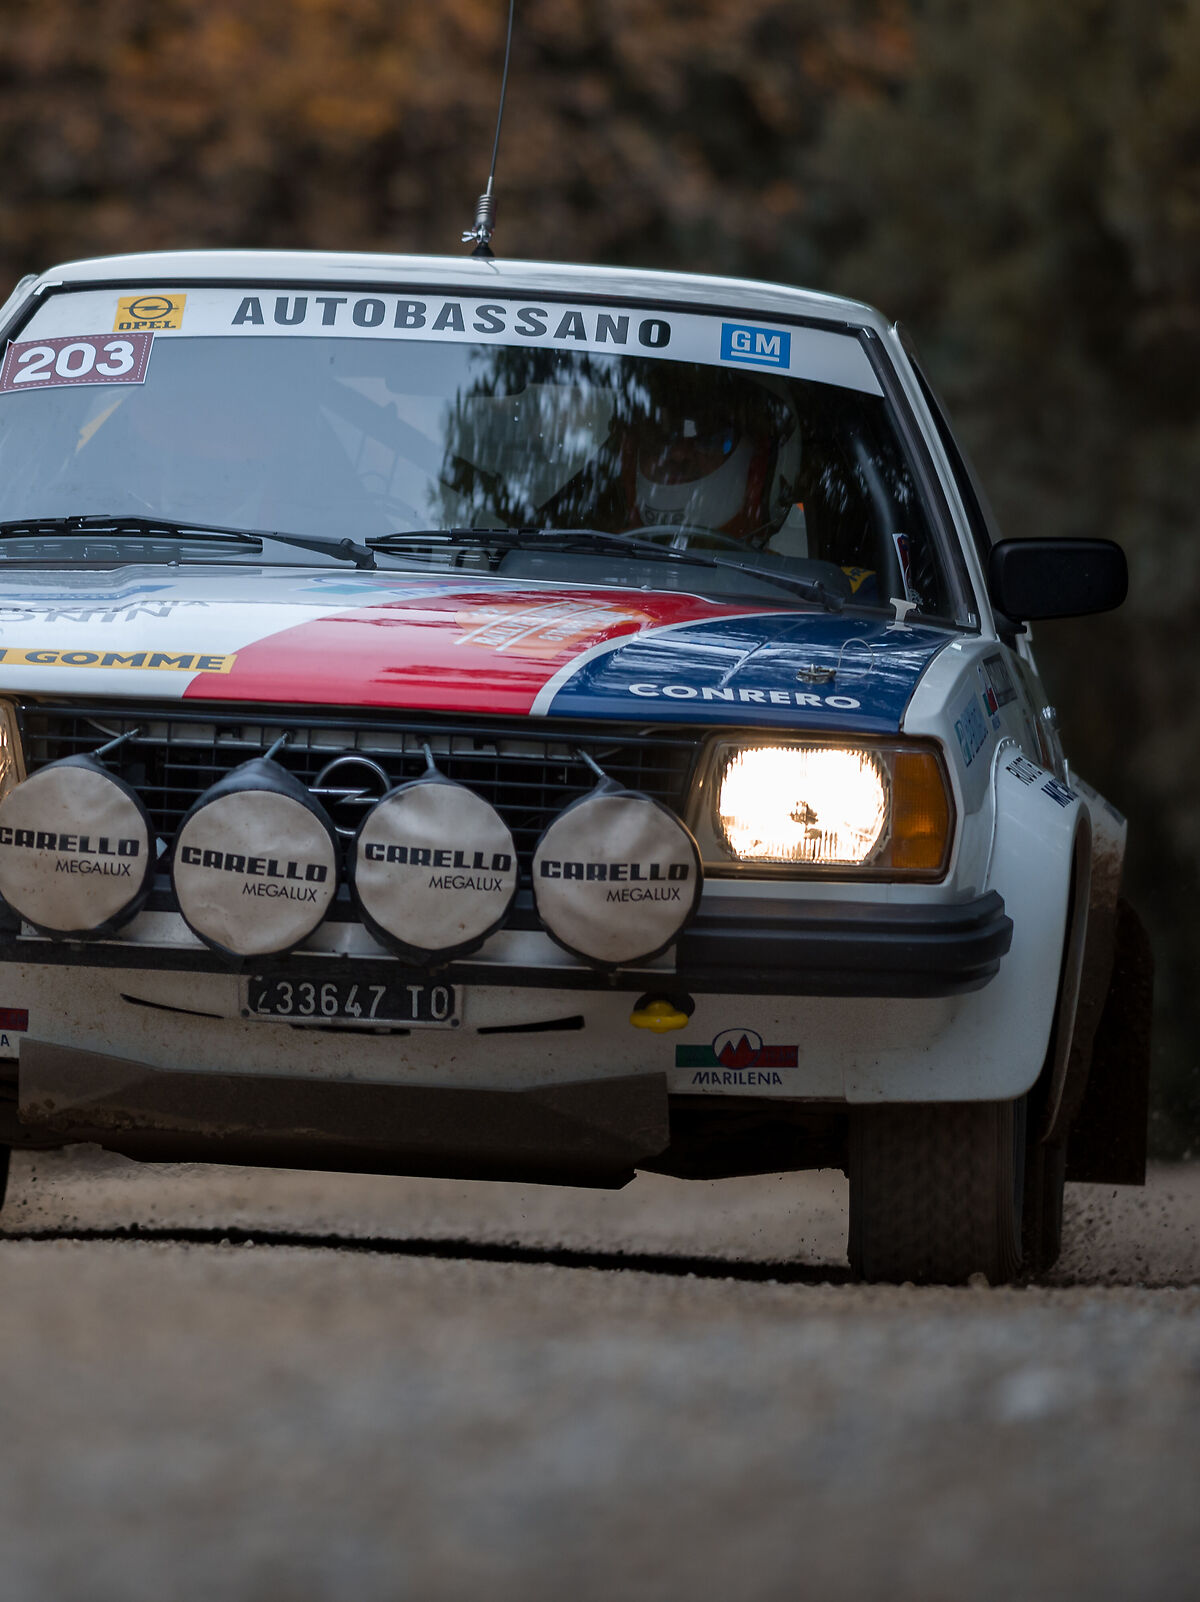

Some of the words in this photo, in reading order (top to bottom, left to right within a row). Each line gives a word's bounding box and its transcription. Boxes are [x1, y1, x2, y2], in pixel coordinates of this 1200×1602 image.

[118, 319, 176, 331] OPEL
[231, 296, 672, 349] AUTOBASSANO
[731, 329, 782, 357] GM
[12, 339, 135, 384] 203
[25, 650, 227, 671] GOMME
[628, 682, 861, 710] CONRERO
[55, 858, 131, 877] MEGALUX
[181, 846, 328, 883] CARELLO
[365, 843, 512, 872] CARELLO
[540, 860, 689, 881] CARELLO
[242, 882, 317, 903] MEGALUX
[429, 875, 502, 892] MEGALUX
[606, 887, 681, 903] MEGALUX
[692, 1071, 783, 1085] MARILENA
